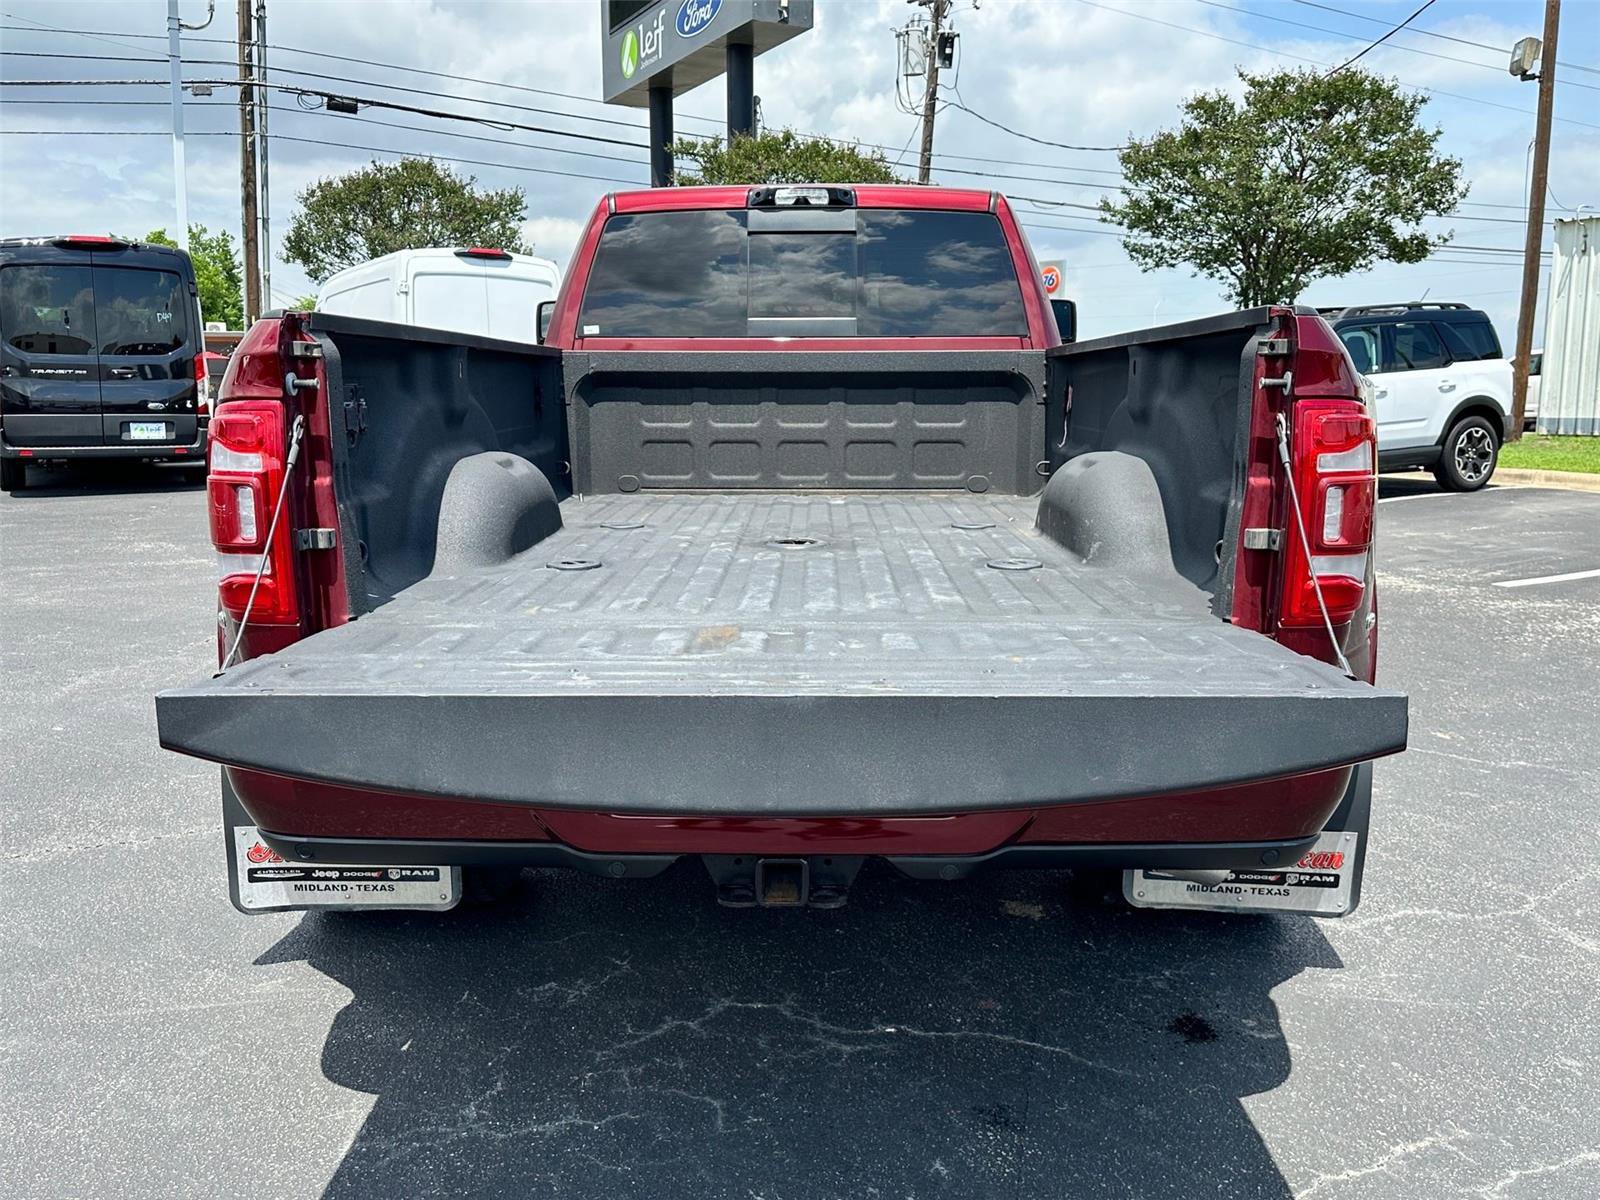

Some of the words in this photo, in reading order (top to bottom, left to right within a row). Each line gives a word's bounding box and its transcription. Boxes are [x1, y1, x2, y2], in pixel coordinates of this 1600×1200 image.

[684, 0, 713, 32] Ford
[1043, 273, 1055, 287] 76
[311, 869, 340, 879] Jeep
[294, 884, 349, 892] MIDLAND
[356, 884, 395, 892] TEXAS
[1250, 887, 1290, 896] TEXAS
